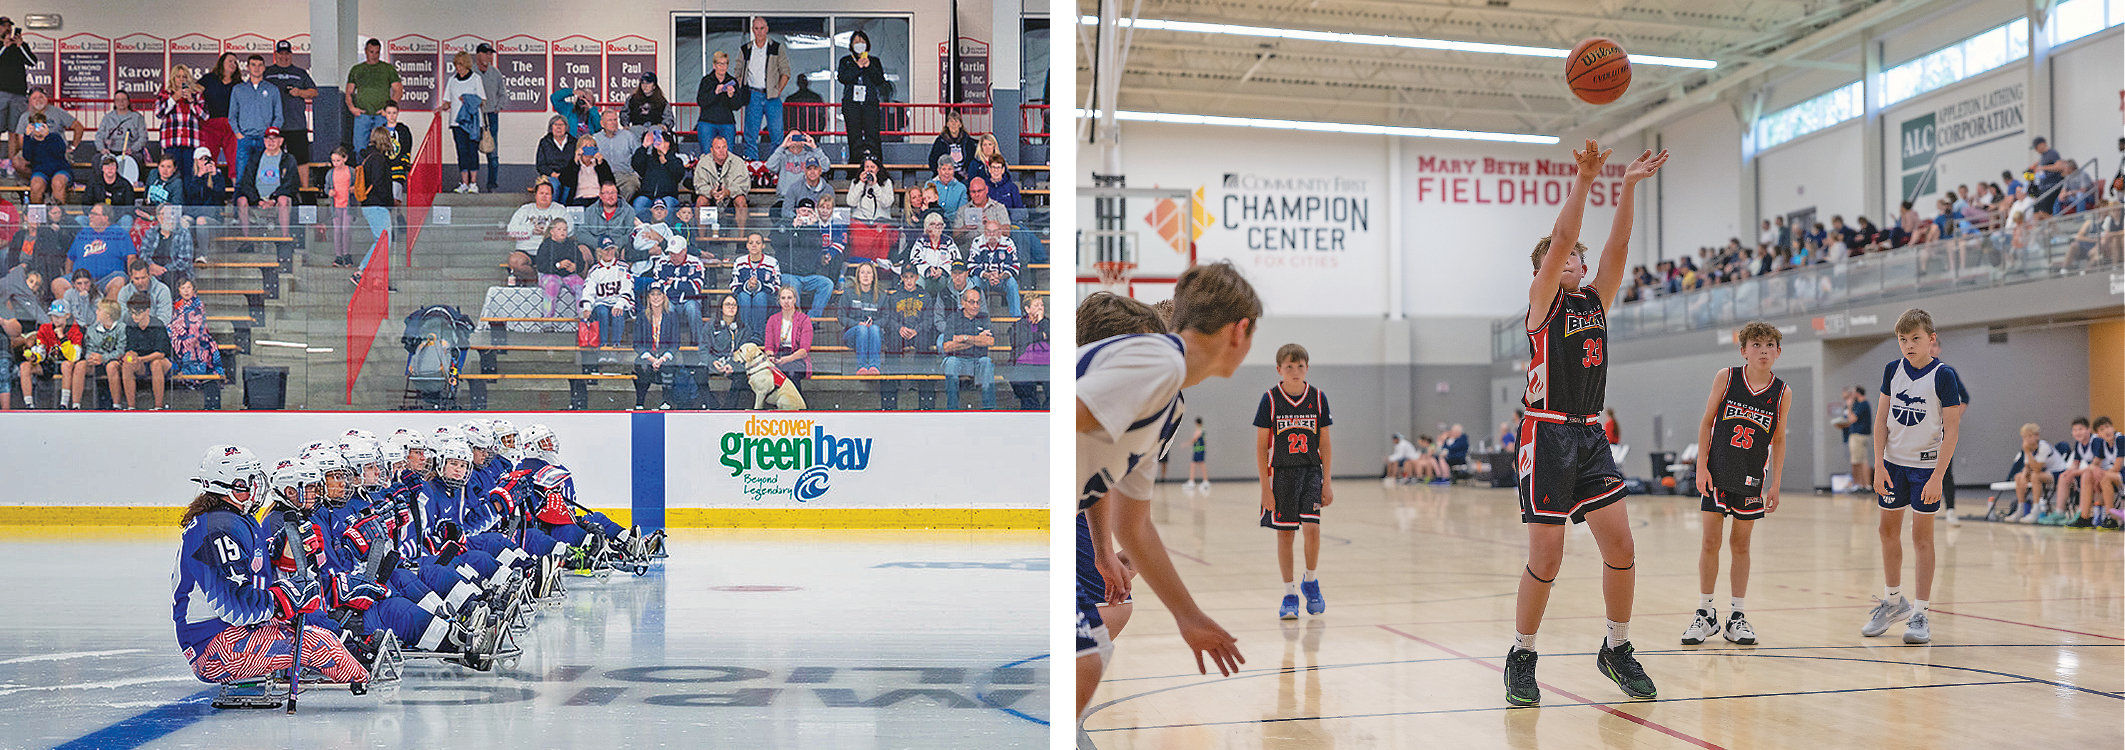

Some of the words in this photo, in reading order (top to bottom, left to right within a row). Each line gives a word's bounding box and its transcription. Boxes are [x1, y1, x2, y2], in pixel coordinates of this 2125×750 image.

[1581, 47, 1622, 66] Wilson
[118, 66, 162, 78] Karow
[394, 60, 433, 72] Summit
[511, 60, 533, 72] The
[565, 62, 590, 74] Tom
[622, 62, 642, 74] Paul
[26, 73, 52, 84] Ann
[559, 76, 569, 89] &
[573, 76, 596, 90] Joni
[610, 76, 619, 88] &
[971, 74, 985, 85] Inc.
[117, 81, 162, 95] Family
[964, 89, 986, 99] Edward
[1939, 97, 1981, 124] APPLETON
[1983, 83, 2024, 111] LATHING
[1937, 103, 2024, 147] CORPORATION
[1903, 123, 1935, 159] ALC
[1418, 156, 1477, 174] MARY
[1484, 157, 1530, 175] BETH
[1242, 174, 1330, 191] COMMUNITY
[1333, 176, 1368, 192] FIRST
[1223, 194, 1368, 232] CHAMPION
[1248, 226, 1345, 250] CENTER
[1254, 255, 1285, 268] FOX
[1290, 256, 1339, 269] CITIES
[596, 280, 622, 298] USA
[1582, 337, 1604, 369] 33
[1726, 399, 1774, 416] WISCONSIN
[745, 415, 815, 437] discover
[1277, 418, 1316, 433] BLAZE
[1724, 404, 1772, 431] BLAZE
[1287, 433, 1309, 454] 23
[1730, 424, 1756, 450] 25
[744, 474, 778, 487] Beyond
[744, 484, 793, 501] Legendary
[213, 535, 241, 565] 19
